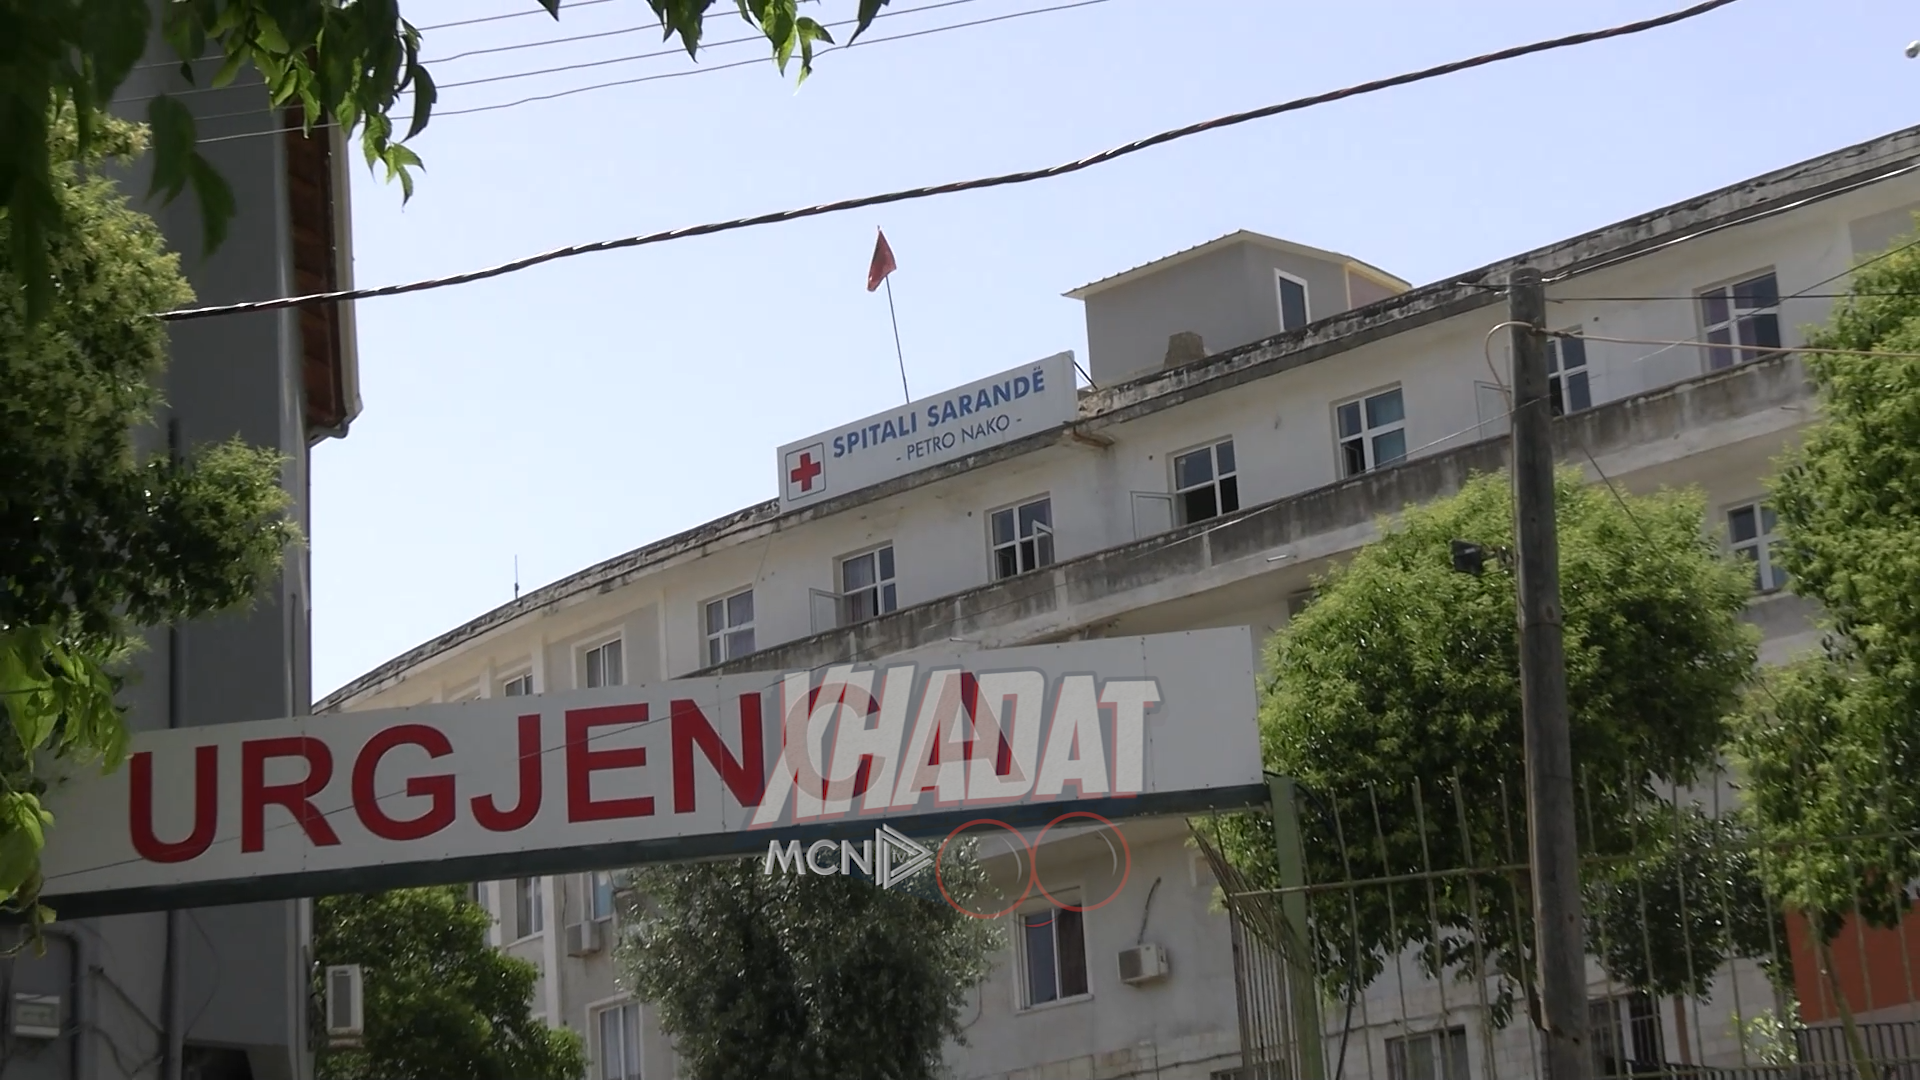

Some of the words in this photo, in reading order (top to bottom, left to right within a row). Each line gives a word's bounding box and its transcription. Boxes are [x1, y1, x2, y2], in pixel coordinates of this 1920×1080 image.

[833, 412, 917, 458] SPITALI
[927, 365, 1046, 428] SARANDË
[907, 431, 956, 461] PETRO
[961, 414, 1010, 444] NAKO
[128, 671, 1027, 864] URGJENCA
